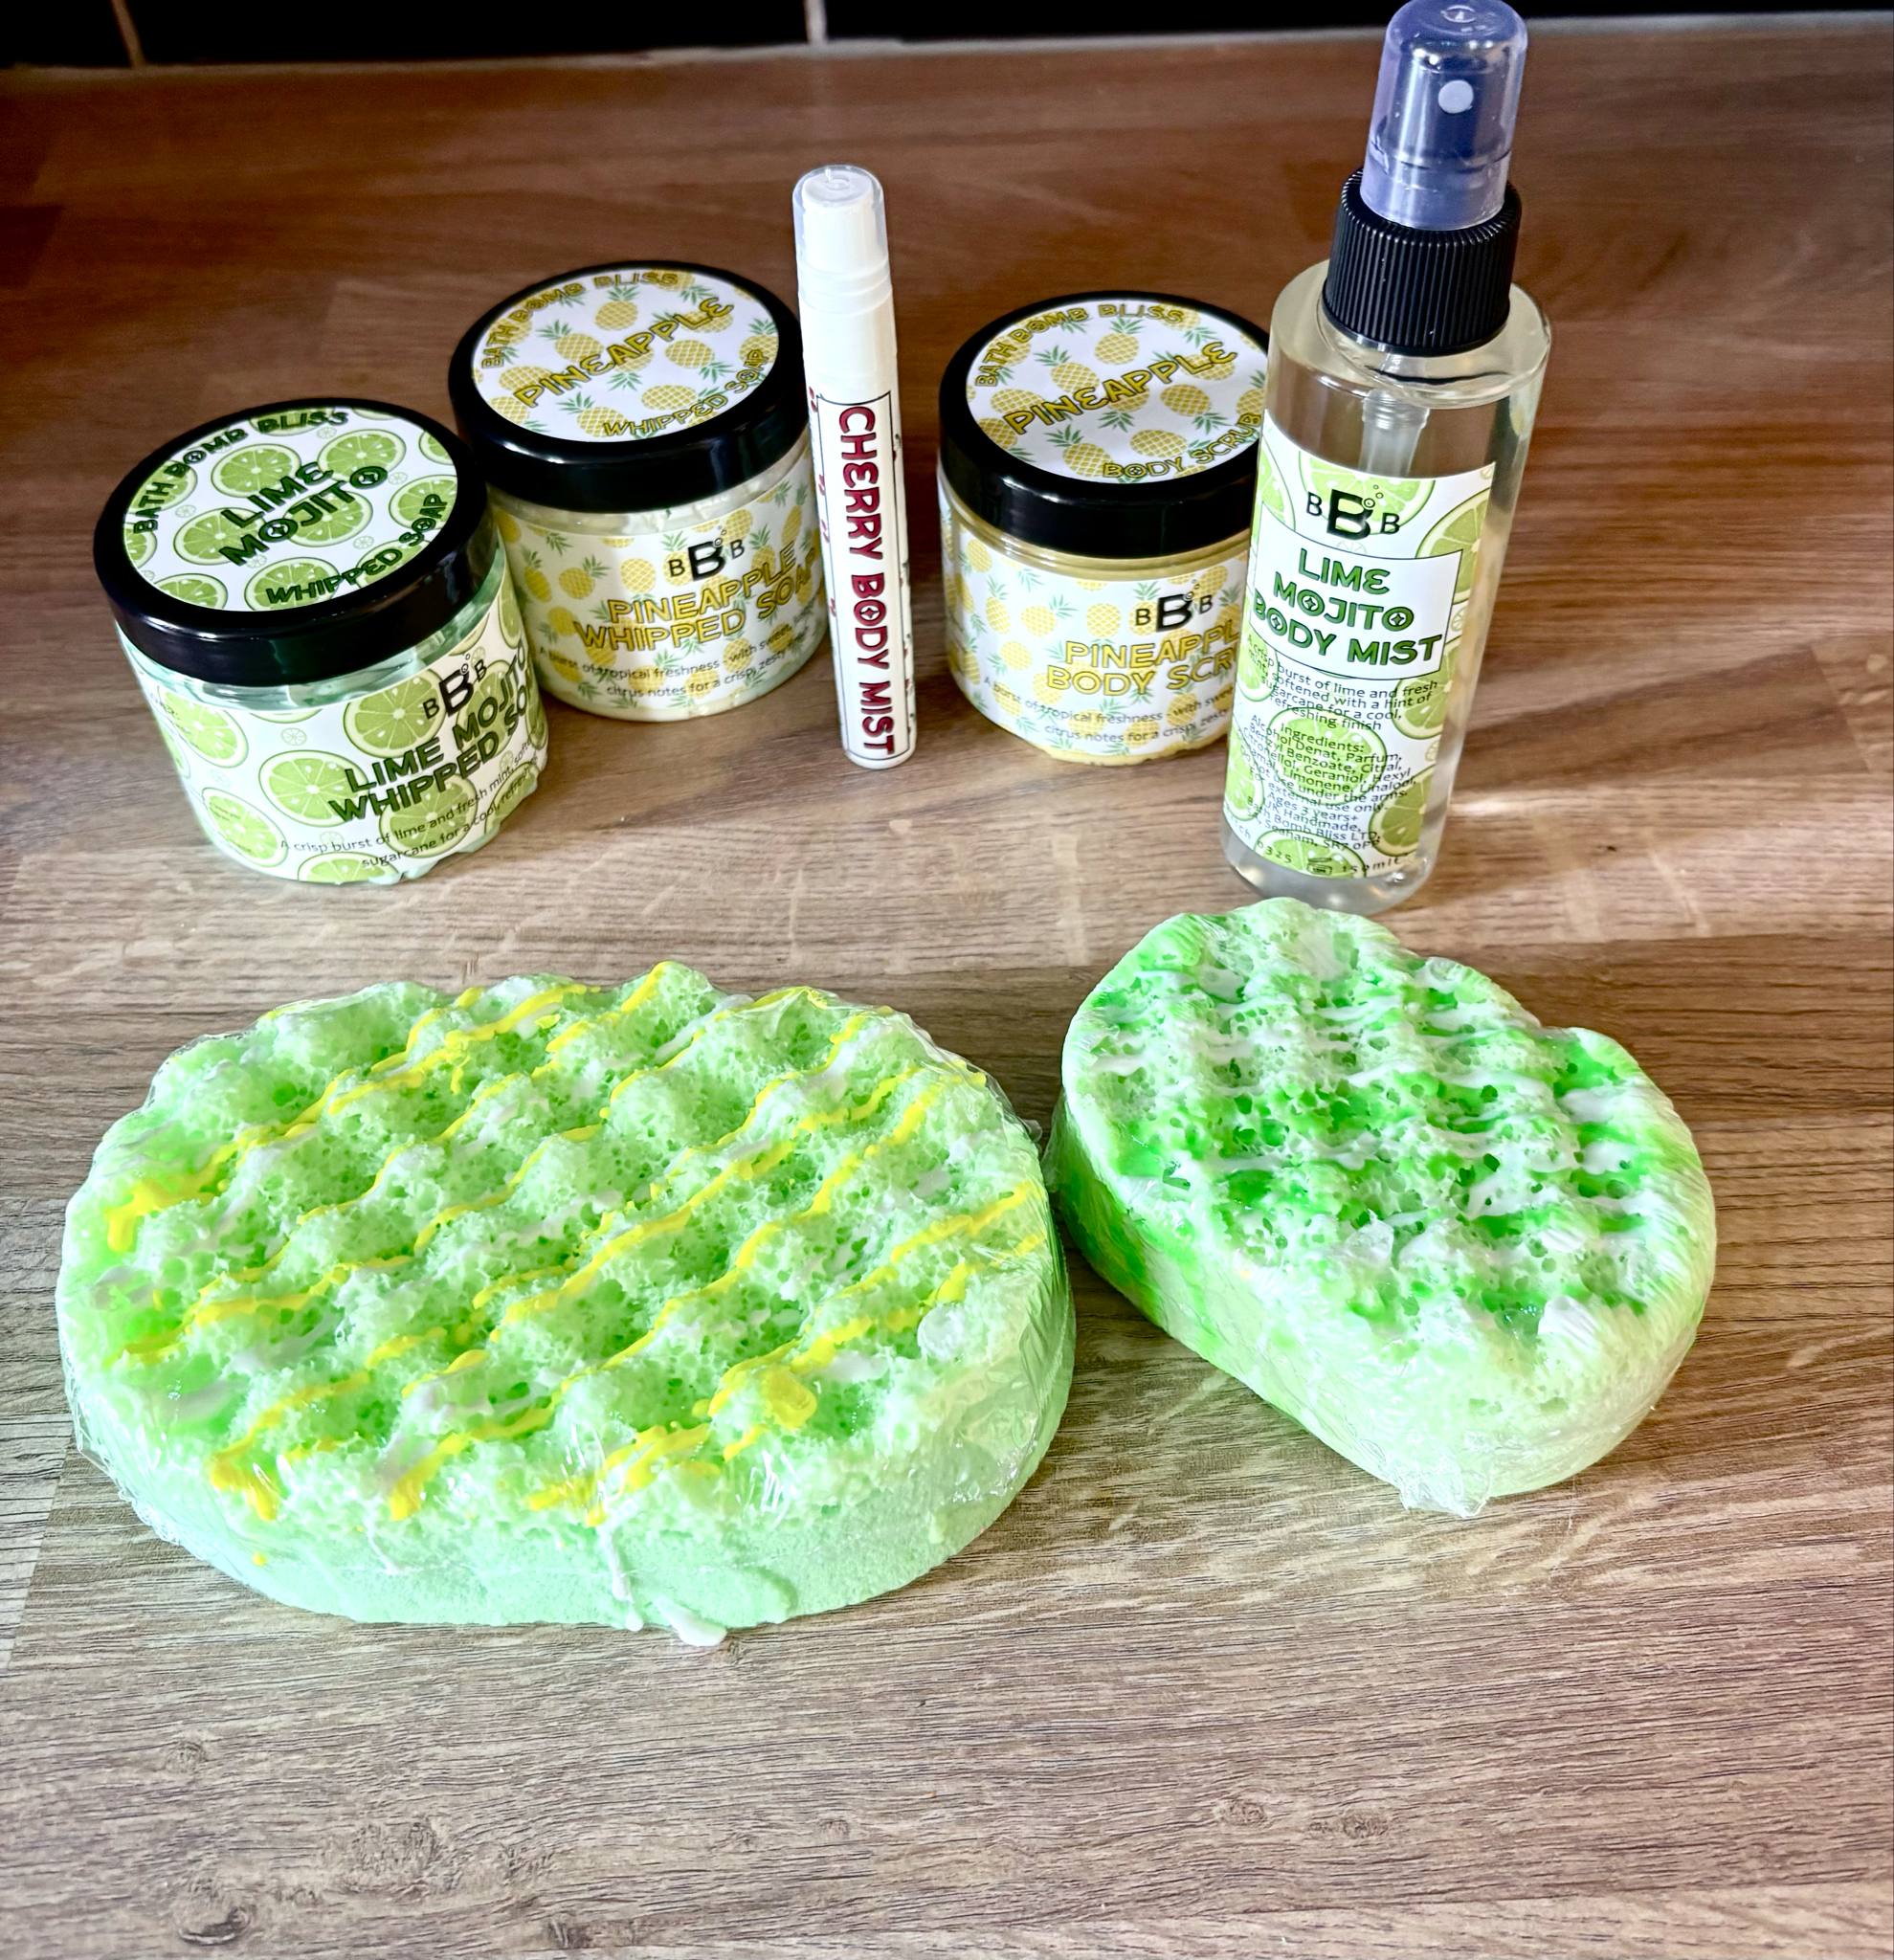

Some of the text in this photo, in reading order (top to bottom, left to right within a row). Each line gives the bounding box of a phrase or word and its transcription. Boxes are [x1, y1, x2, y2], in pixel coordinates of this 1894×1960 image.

[481, 272, 678, 368] BATH BOMB BLISS
[513, 297, 734, 408] PINEAPPLE
[974, 303, 1185, 387] BATH BOMB BLISS
[603, 348, 769, 436] WHIPPED SOAP
[1003, 341, 1237, 435] PINEAPPLE
[134, 411, 348, 533] BATH BOMB BLISS
[1103, 412, 1261, 479] BODY SCRUB
[219, 466, 388, 566] MOJITO
[221, 461, 334, 528] LIME
[266, 494, 448, 604] WHIPPED SOAP
[607, 541, 796, 624] PINEAPPLE
[838, 406, 895, 755] CHERRY BODY MIST
[1298, 547, 1391, 595] LIME
[572, 608, 746, 652] WHIPPED
[1253, 588, 1443, 666] BODY MIST
[1273, 571, 1415, 632] MOJITO
[1047, 643, 1237, 697] BODY SCR
[1065, 619, 1241, 669] PINEAPPL
[1272, 672, 1330, 702] softened
[1334, 697, 1367, 709] with
[1370, 701, 1379, 709] a
[1384, 698, 1414, 708] hint
[1416, 691, 1432, 704] of
[1278, 661, 1311, 685] burst
[1315, 681, 1331, 690] of
[1334, 682, 1366, 697] lime
[1370, 687, 1397, 699] and
[1403, 680, 1437, 697] fresh
[1328, 704, 1350, 717] for
[1353, 710, 1362, 719] a
[345, 638, 525, 793] LIME MOJITO
[1085, 731, 1124, 743] notes
[1097, 712, 1163, 724] freshness
[1281, 723, 1365, 753] Ingredients:
[1342, 719, 1382, 730] finish
[328, 731, 499, 822] WHIPPED
[294, 842, 327, 854] crisp
[332, 837, 373, 852] burst
[376, 834, 390, 844] of
[393, 824, 426, 840] lime
[430, 807, 455, 827] and
[457, 788, 487, 813] fresh
[362, 839, 436, 867] sugarcane
[438, 829, 464, 845] for
[464, 823, 471, 833] a
